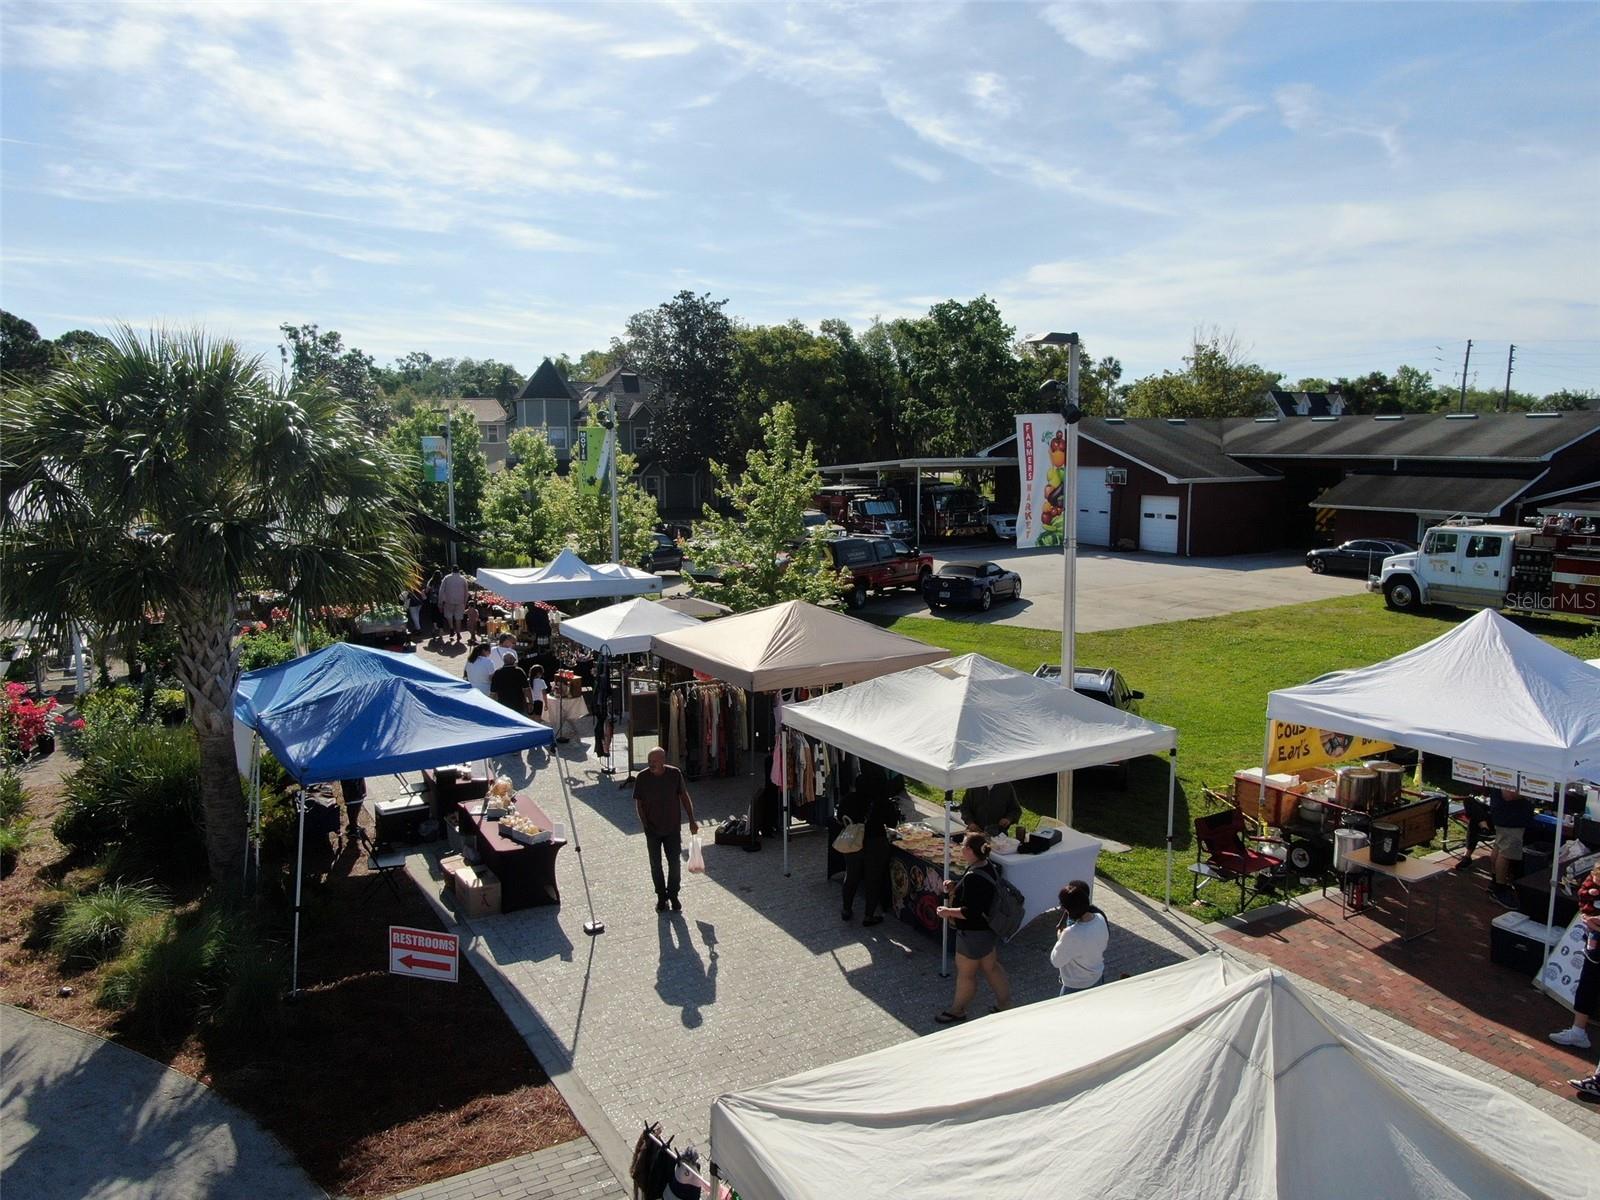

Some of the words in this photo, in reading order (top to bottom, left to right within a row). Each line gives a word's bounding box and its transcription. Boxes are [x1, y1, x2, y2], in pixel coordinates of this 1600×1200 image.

[1024, 424, 1033, 480] FARMERS
[1024, 483, 1033, 539] MARKET
[392, 932, 456, 952] RESTROOMS
